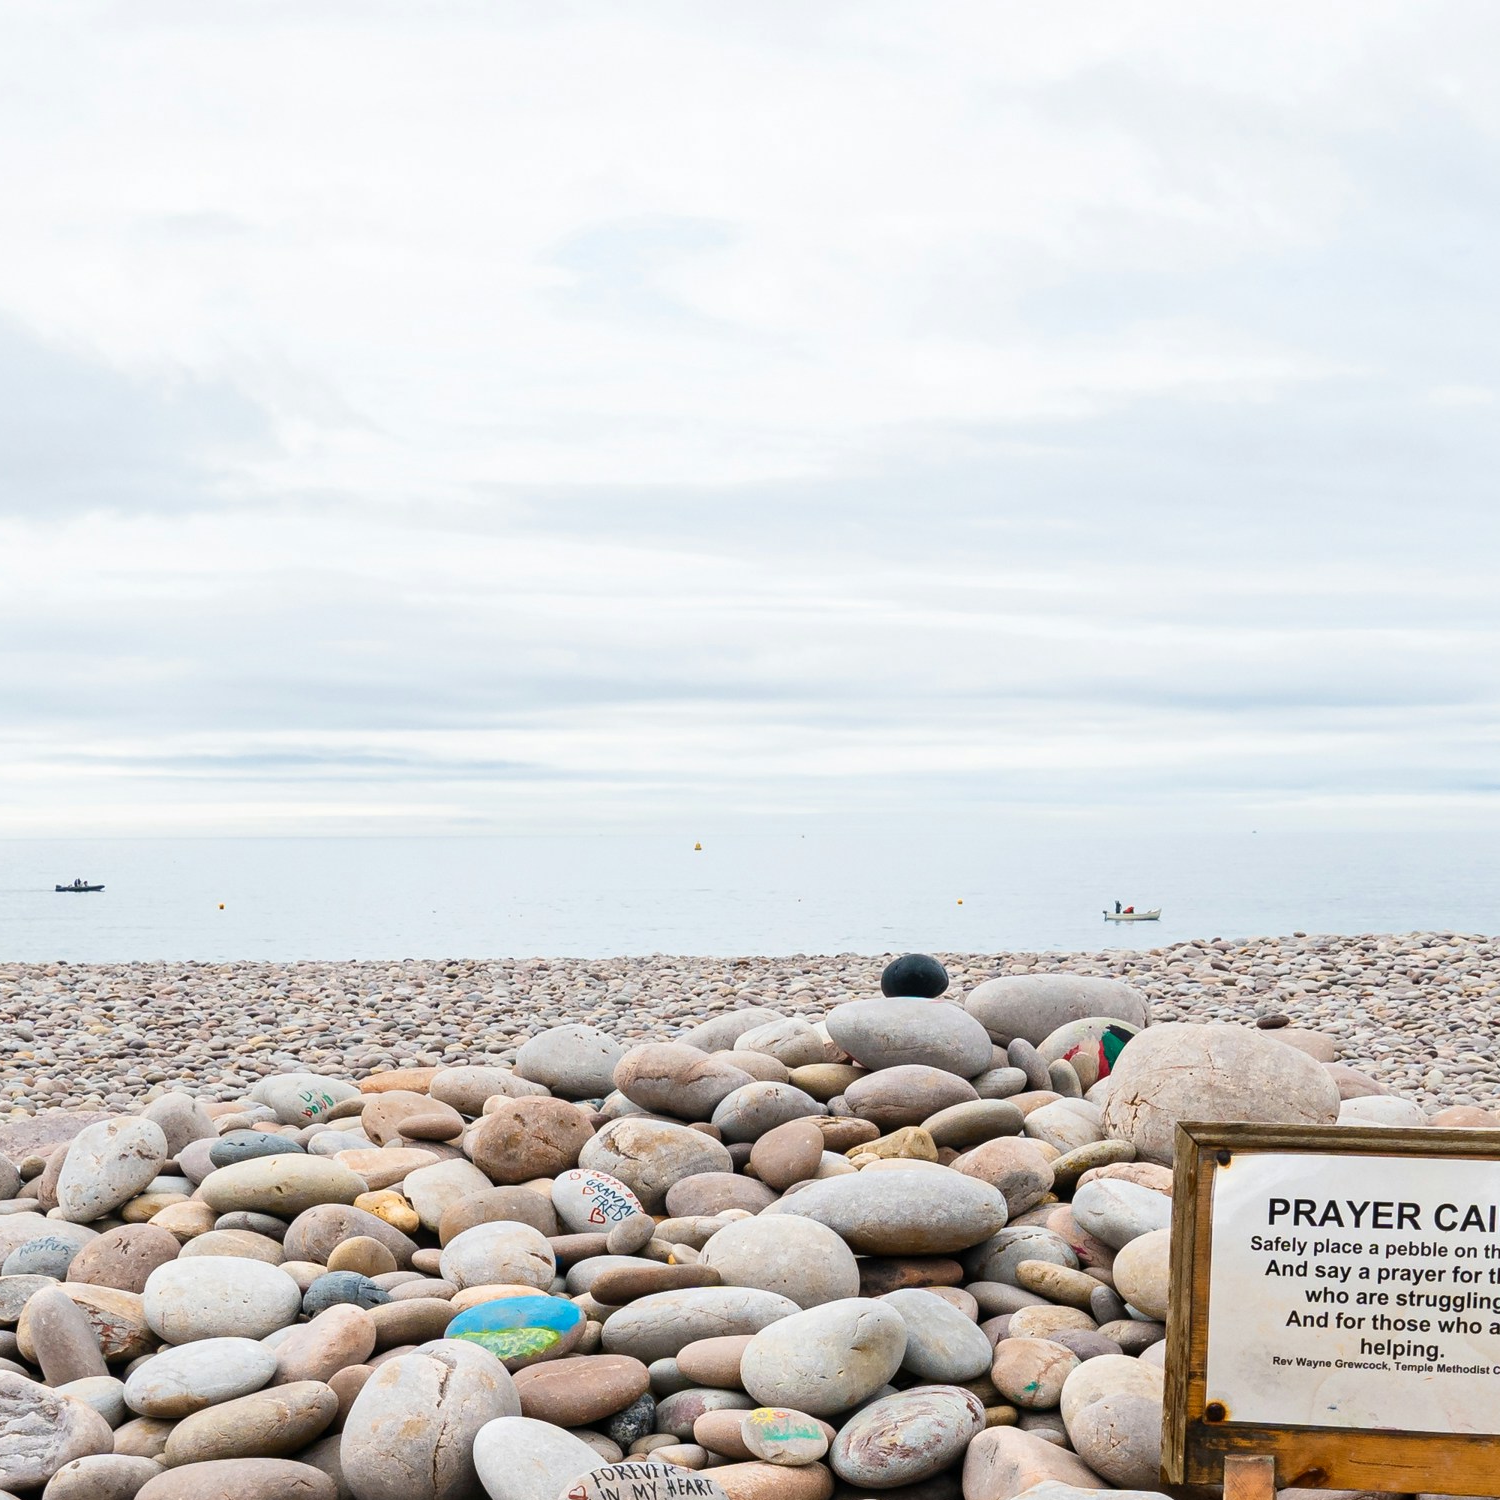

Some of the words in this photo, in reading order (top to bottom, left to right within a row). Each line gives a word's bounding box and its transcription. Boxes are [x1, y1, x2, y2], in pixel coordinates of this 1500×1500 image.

[592, 1195, 623, 1221] FRED
[1268, 1198, 1422, 1231] PRAYER
[1250, 1235, 1308, 1257] Safely
[1313, 1238, 1363, 1257] place
[1368, 1243, 1379, 1255] a
[1385, 1241, 1448, 1259] pebble
[1454, 1246, 1478, 1259] on
[1264, 1259, 1308, 1278] And
[1314, 1264, 1352, 1284] say
[1358, 1266, 1370, 1280] a
[1377, 1267, 1447, 1286] prayer
[1451, 1265, 1483, 1284] for
[1304, 1286, 1349, 1304] who
[1355, 1291, 1389, 1306] are
[1285, 1310, 1329, 1328] And
[1335, 1311, 1366, 1330] for
[1371, 1313, 1431, 1333] those
[1437, 1316, 1483, 1335] who
[1360, 1337, 1445, 1362] helping.
[1272, 1356, 1294, 1366] Rev
[1295, 1357, 1332, 1370] Wayne
[1334, 1358, 1392, 1372] Grewcock,
[1394, 1361, 1434, 1374] Temple
[1436, 1363, 1490, 1375] Methodist
[590, 1463, 676, 1488] FOREVER
[634, 1483, 658, 1500] MY
[666, 1478, 714, 1498] HEART
